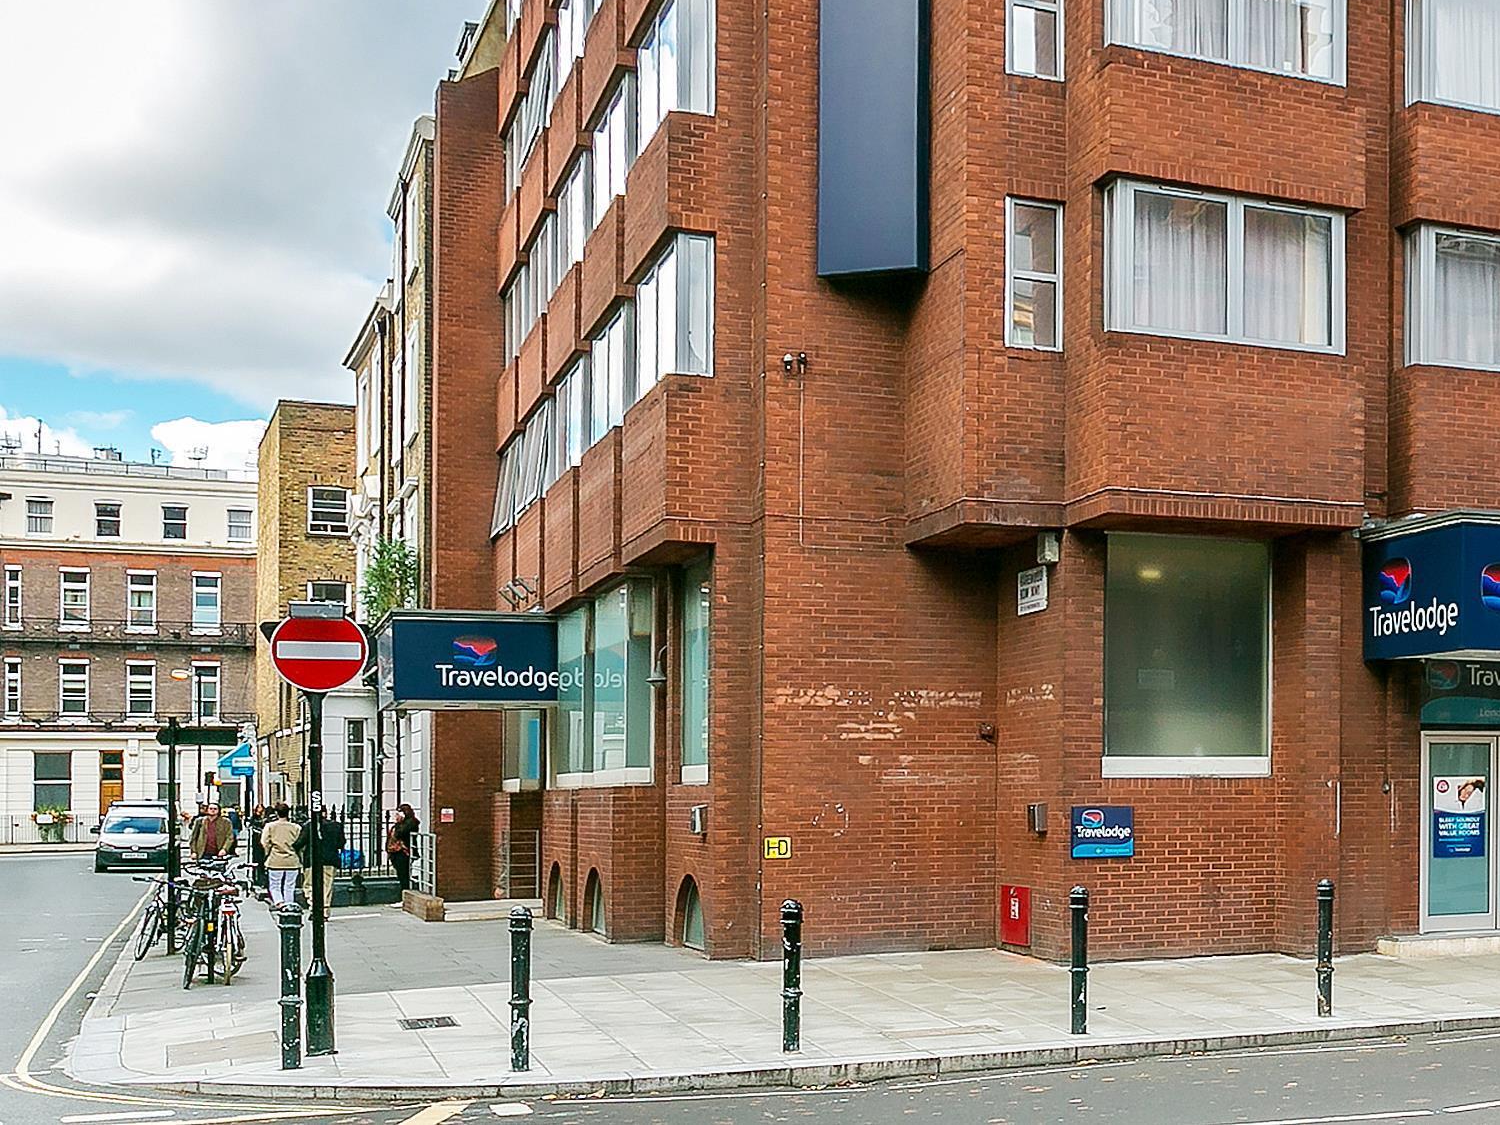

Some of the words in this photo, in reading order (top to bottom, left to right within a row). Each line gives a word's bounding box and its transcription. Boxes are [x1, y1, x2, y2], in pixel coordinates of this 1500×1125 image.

[1369, 597, 1458, 638] Travelodge
[435, 664, 560, 692] Travelodge
[1075, 825, 1131, 840] Travelodge
